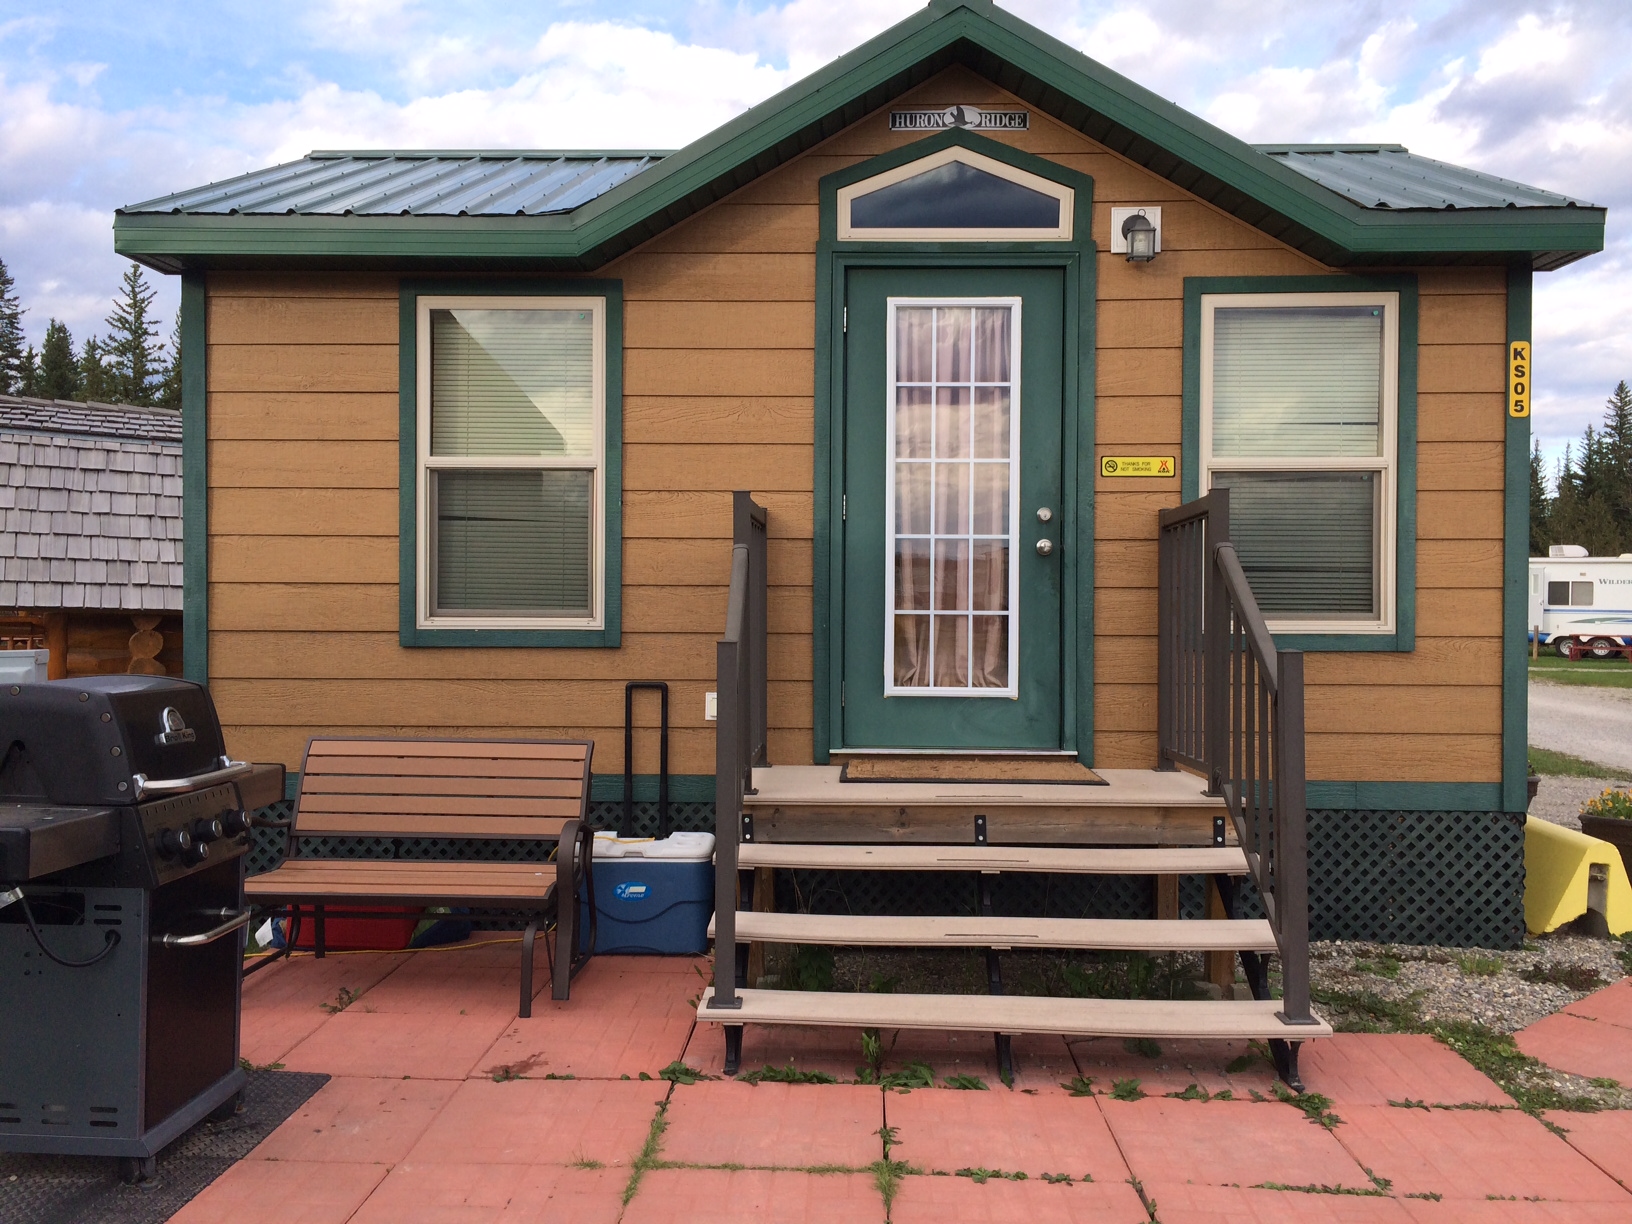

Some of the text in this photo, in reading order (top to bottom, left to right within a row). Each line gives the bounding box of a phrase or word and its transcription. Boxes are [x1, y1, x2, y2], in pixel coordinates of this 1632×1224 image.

[894, 113, 1024, 128] HURON RIDGE
[1513, 347, 1527, 413] KS05
